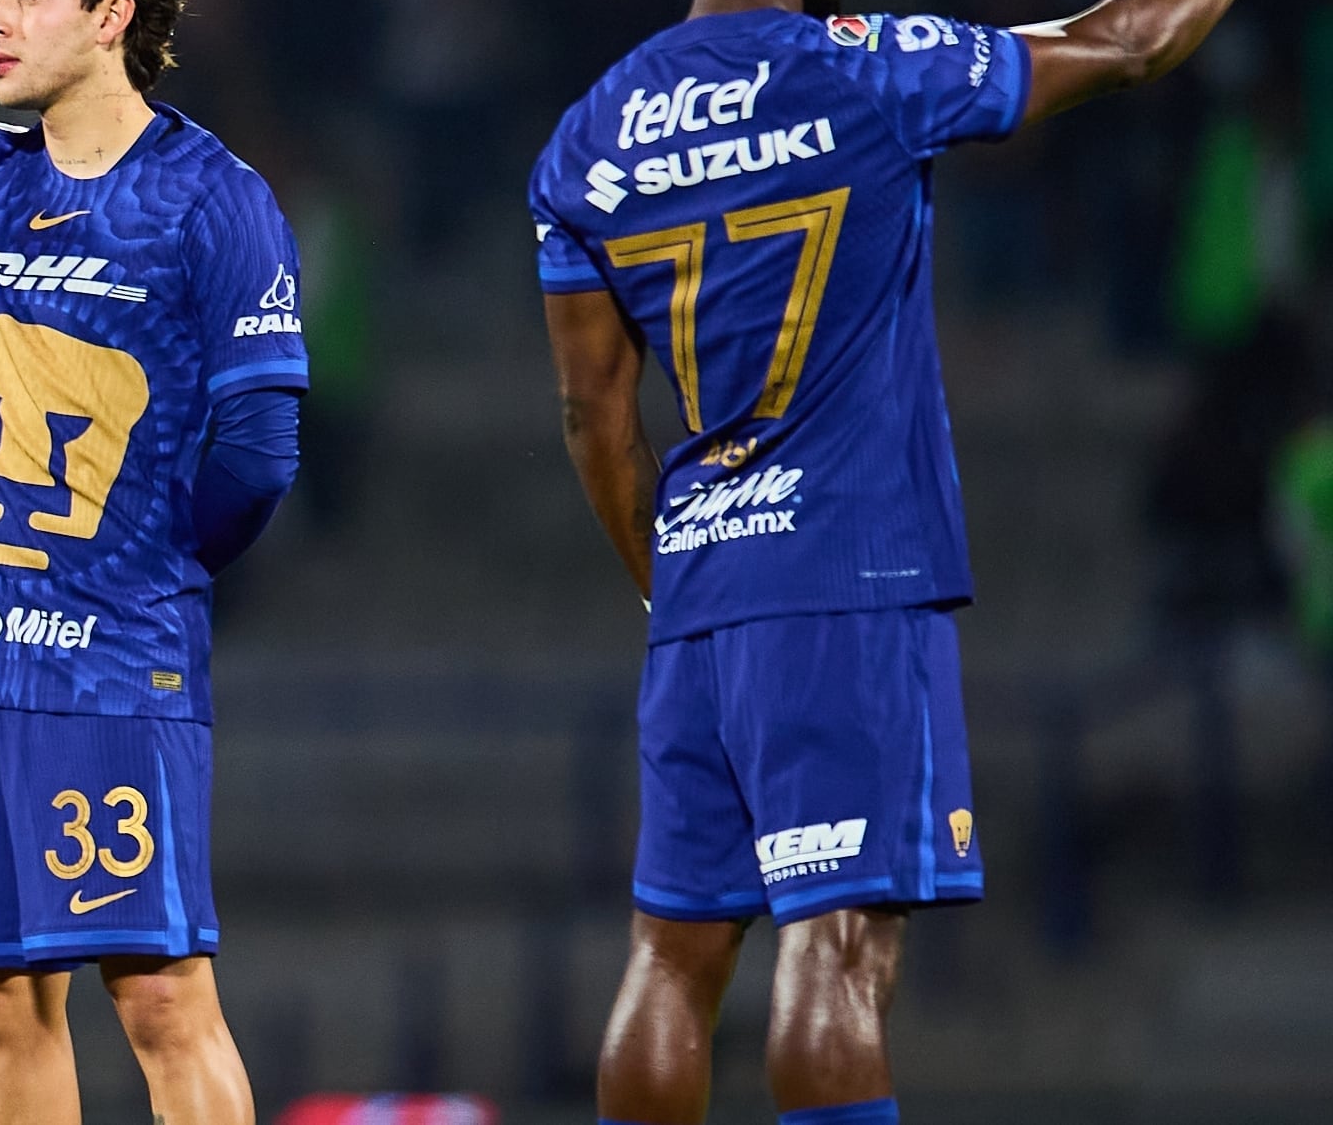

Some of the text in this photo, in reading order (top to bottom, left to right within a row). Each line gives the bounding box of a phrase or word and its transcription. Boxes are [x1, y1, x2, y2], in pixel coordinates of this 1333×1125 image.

[617, 61, 771, 150] telcel
[634, 118, 836, 195] SUZUKI
[605, 187, 851, 433] 77
[5, 607, 98, 649] Mifel
[44, 786, 155, 880] 33
